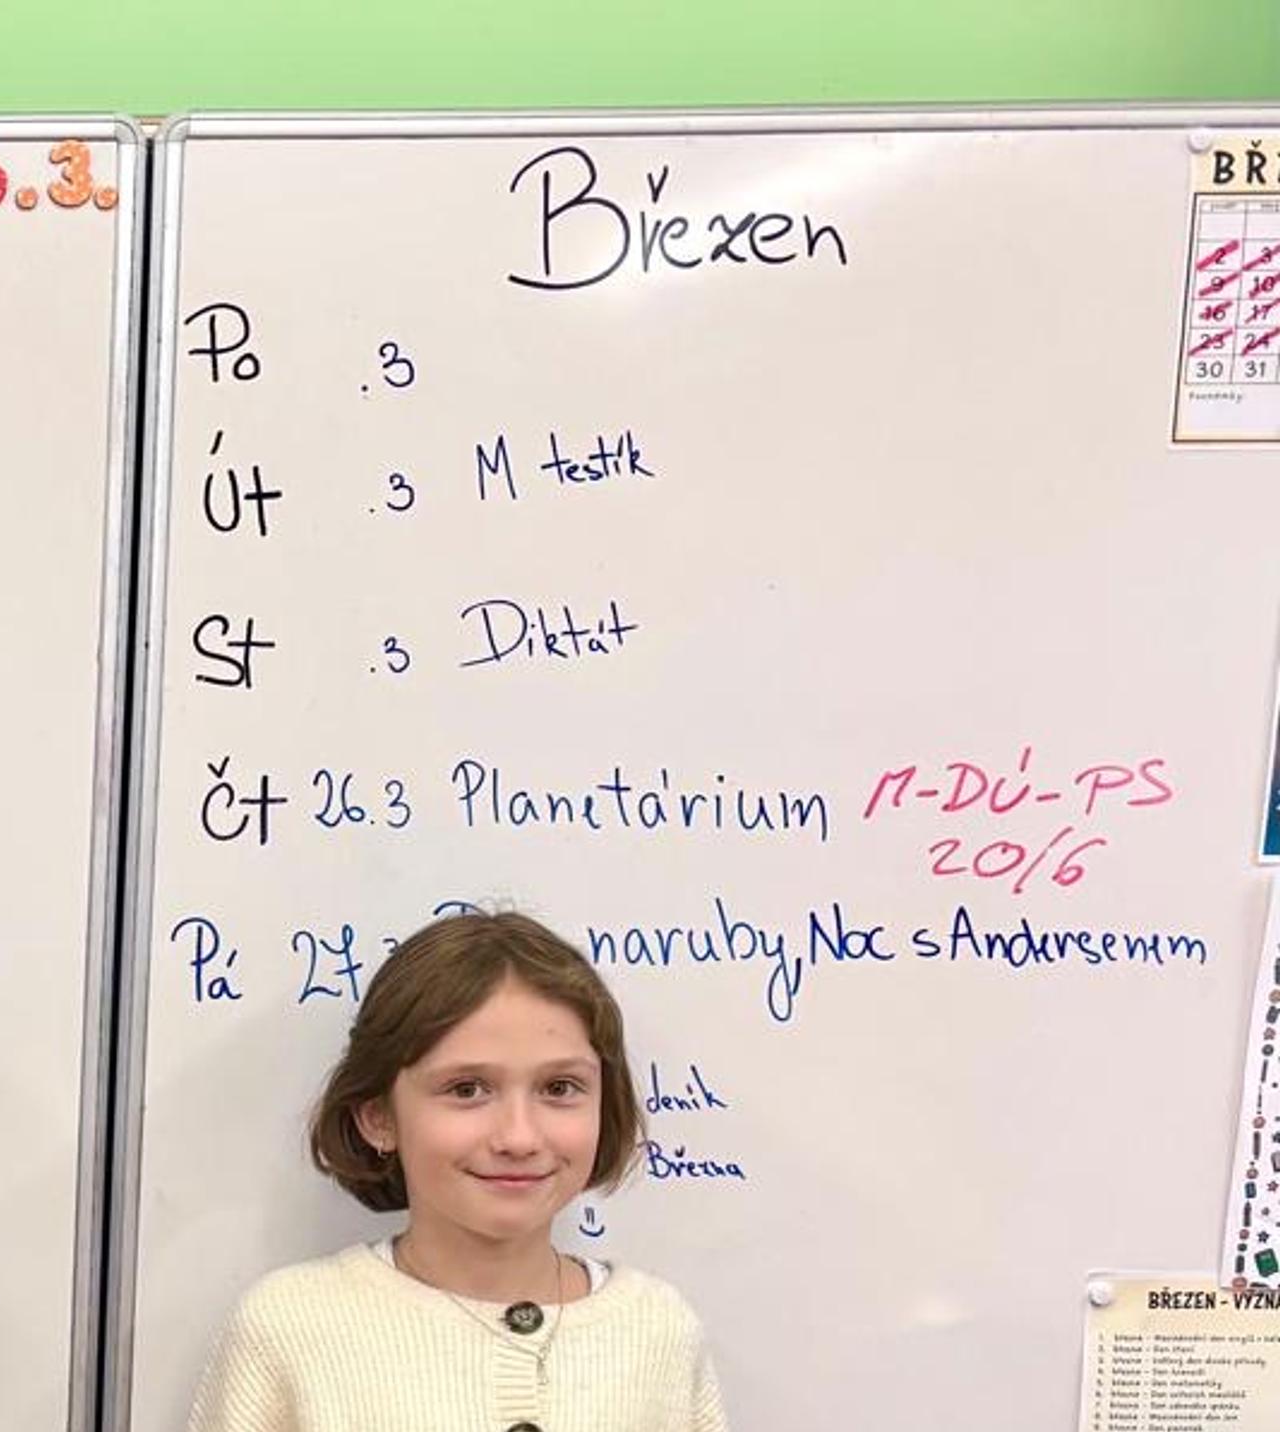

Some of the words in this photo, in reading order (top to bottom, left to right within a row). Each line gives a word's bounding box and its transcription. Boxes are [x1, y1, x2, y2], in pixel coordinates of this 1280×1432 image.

[1213, 139, 1280, 184] BŘ
[509, 147, 847, 289] Březen
[184, 302, 260, 383] Po
[1196, 361, 1224, 379] 30
[1244, 361, 1267, 379] 31
[203, 431, 282, 536] Út
[476, 435, 517, 501] M
[192, 615, 275, 689] St
[460, 599, 639, 668] Diktát
[201, 756, 288, 845] Čt
[313, 769, 412, 829] 26.3
[451, 760, 830, 843] Planetárium
[928, 827, 1107, 895] 20/6
[171, 918, 243, 1002] Pá
[809, 903, 896, 966] Noc
[914, 928, 940, 958] s
[949, 906, 1207, 968] Andersenem
[1148, 1287, 1217, 1310] BŘEZEN
